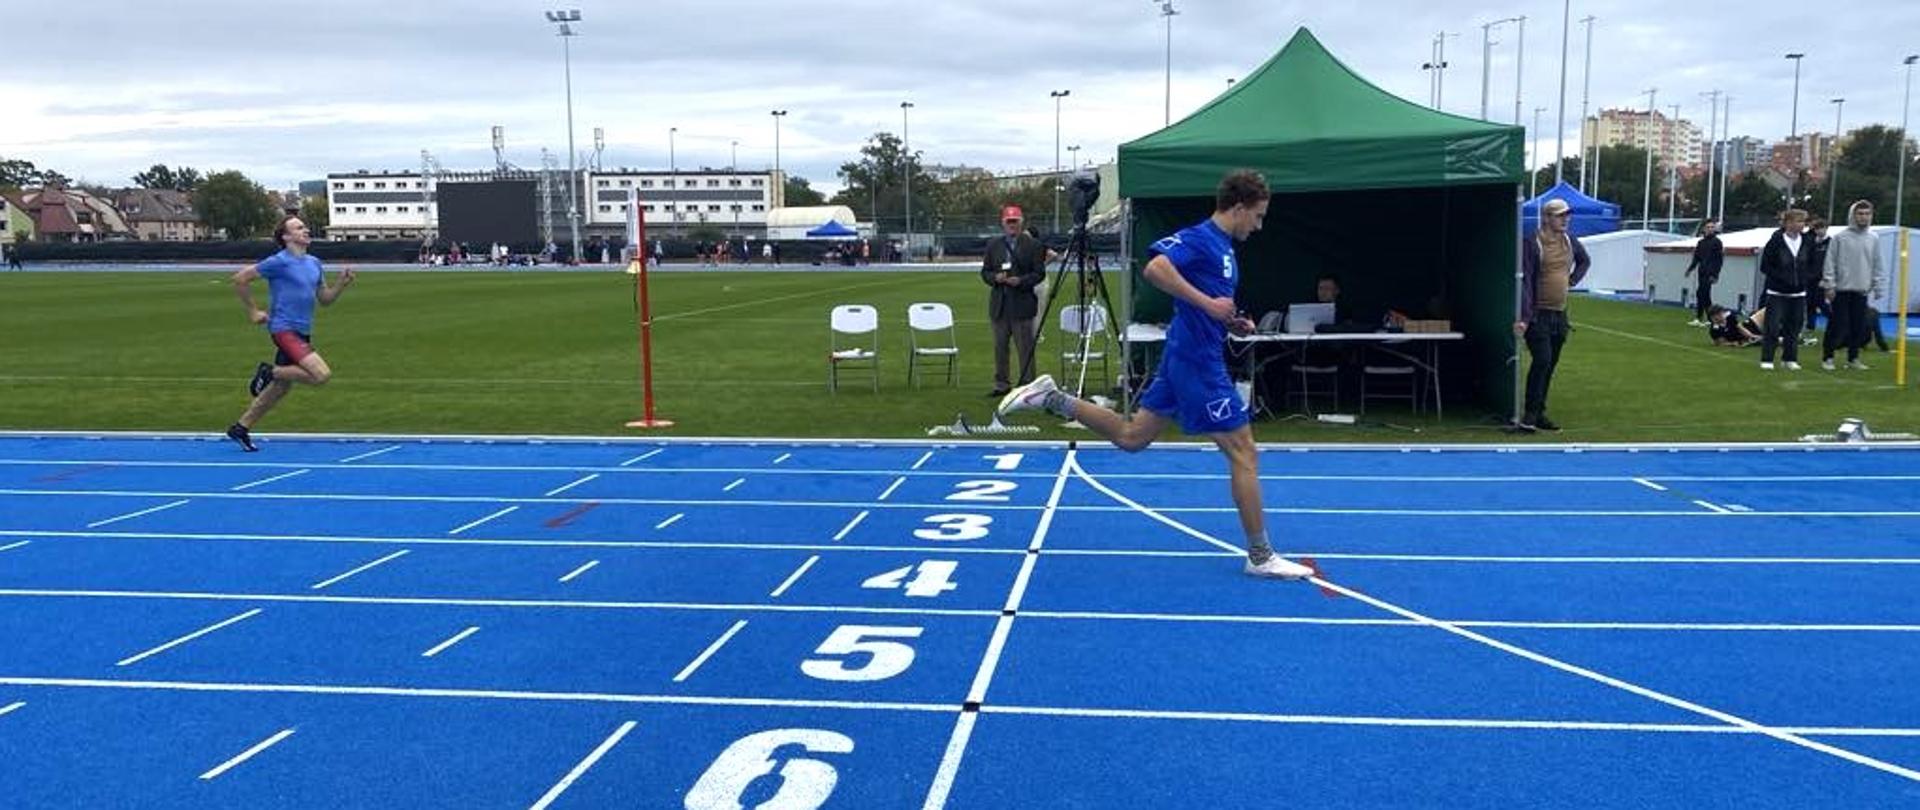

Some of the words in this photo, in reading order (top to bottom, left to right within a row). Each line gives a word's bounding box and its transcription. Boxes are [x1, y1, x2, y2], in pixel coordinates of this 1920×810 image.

[1223, 255, 1233, 278] 5
[983, 453, 1024, 470] 1
[945, 480, 1019, 501] 2
[913, 513, 993, 541] 3
[861, 560, 958, 597] 4
[800, 624, 924, 682] 5
[683, 728, 855, 810] 6
